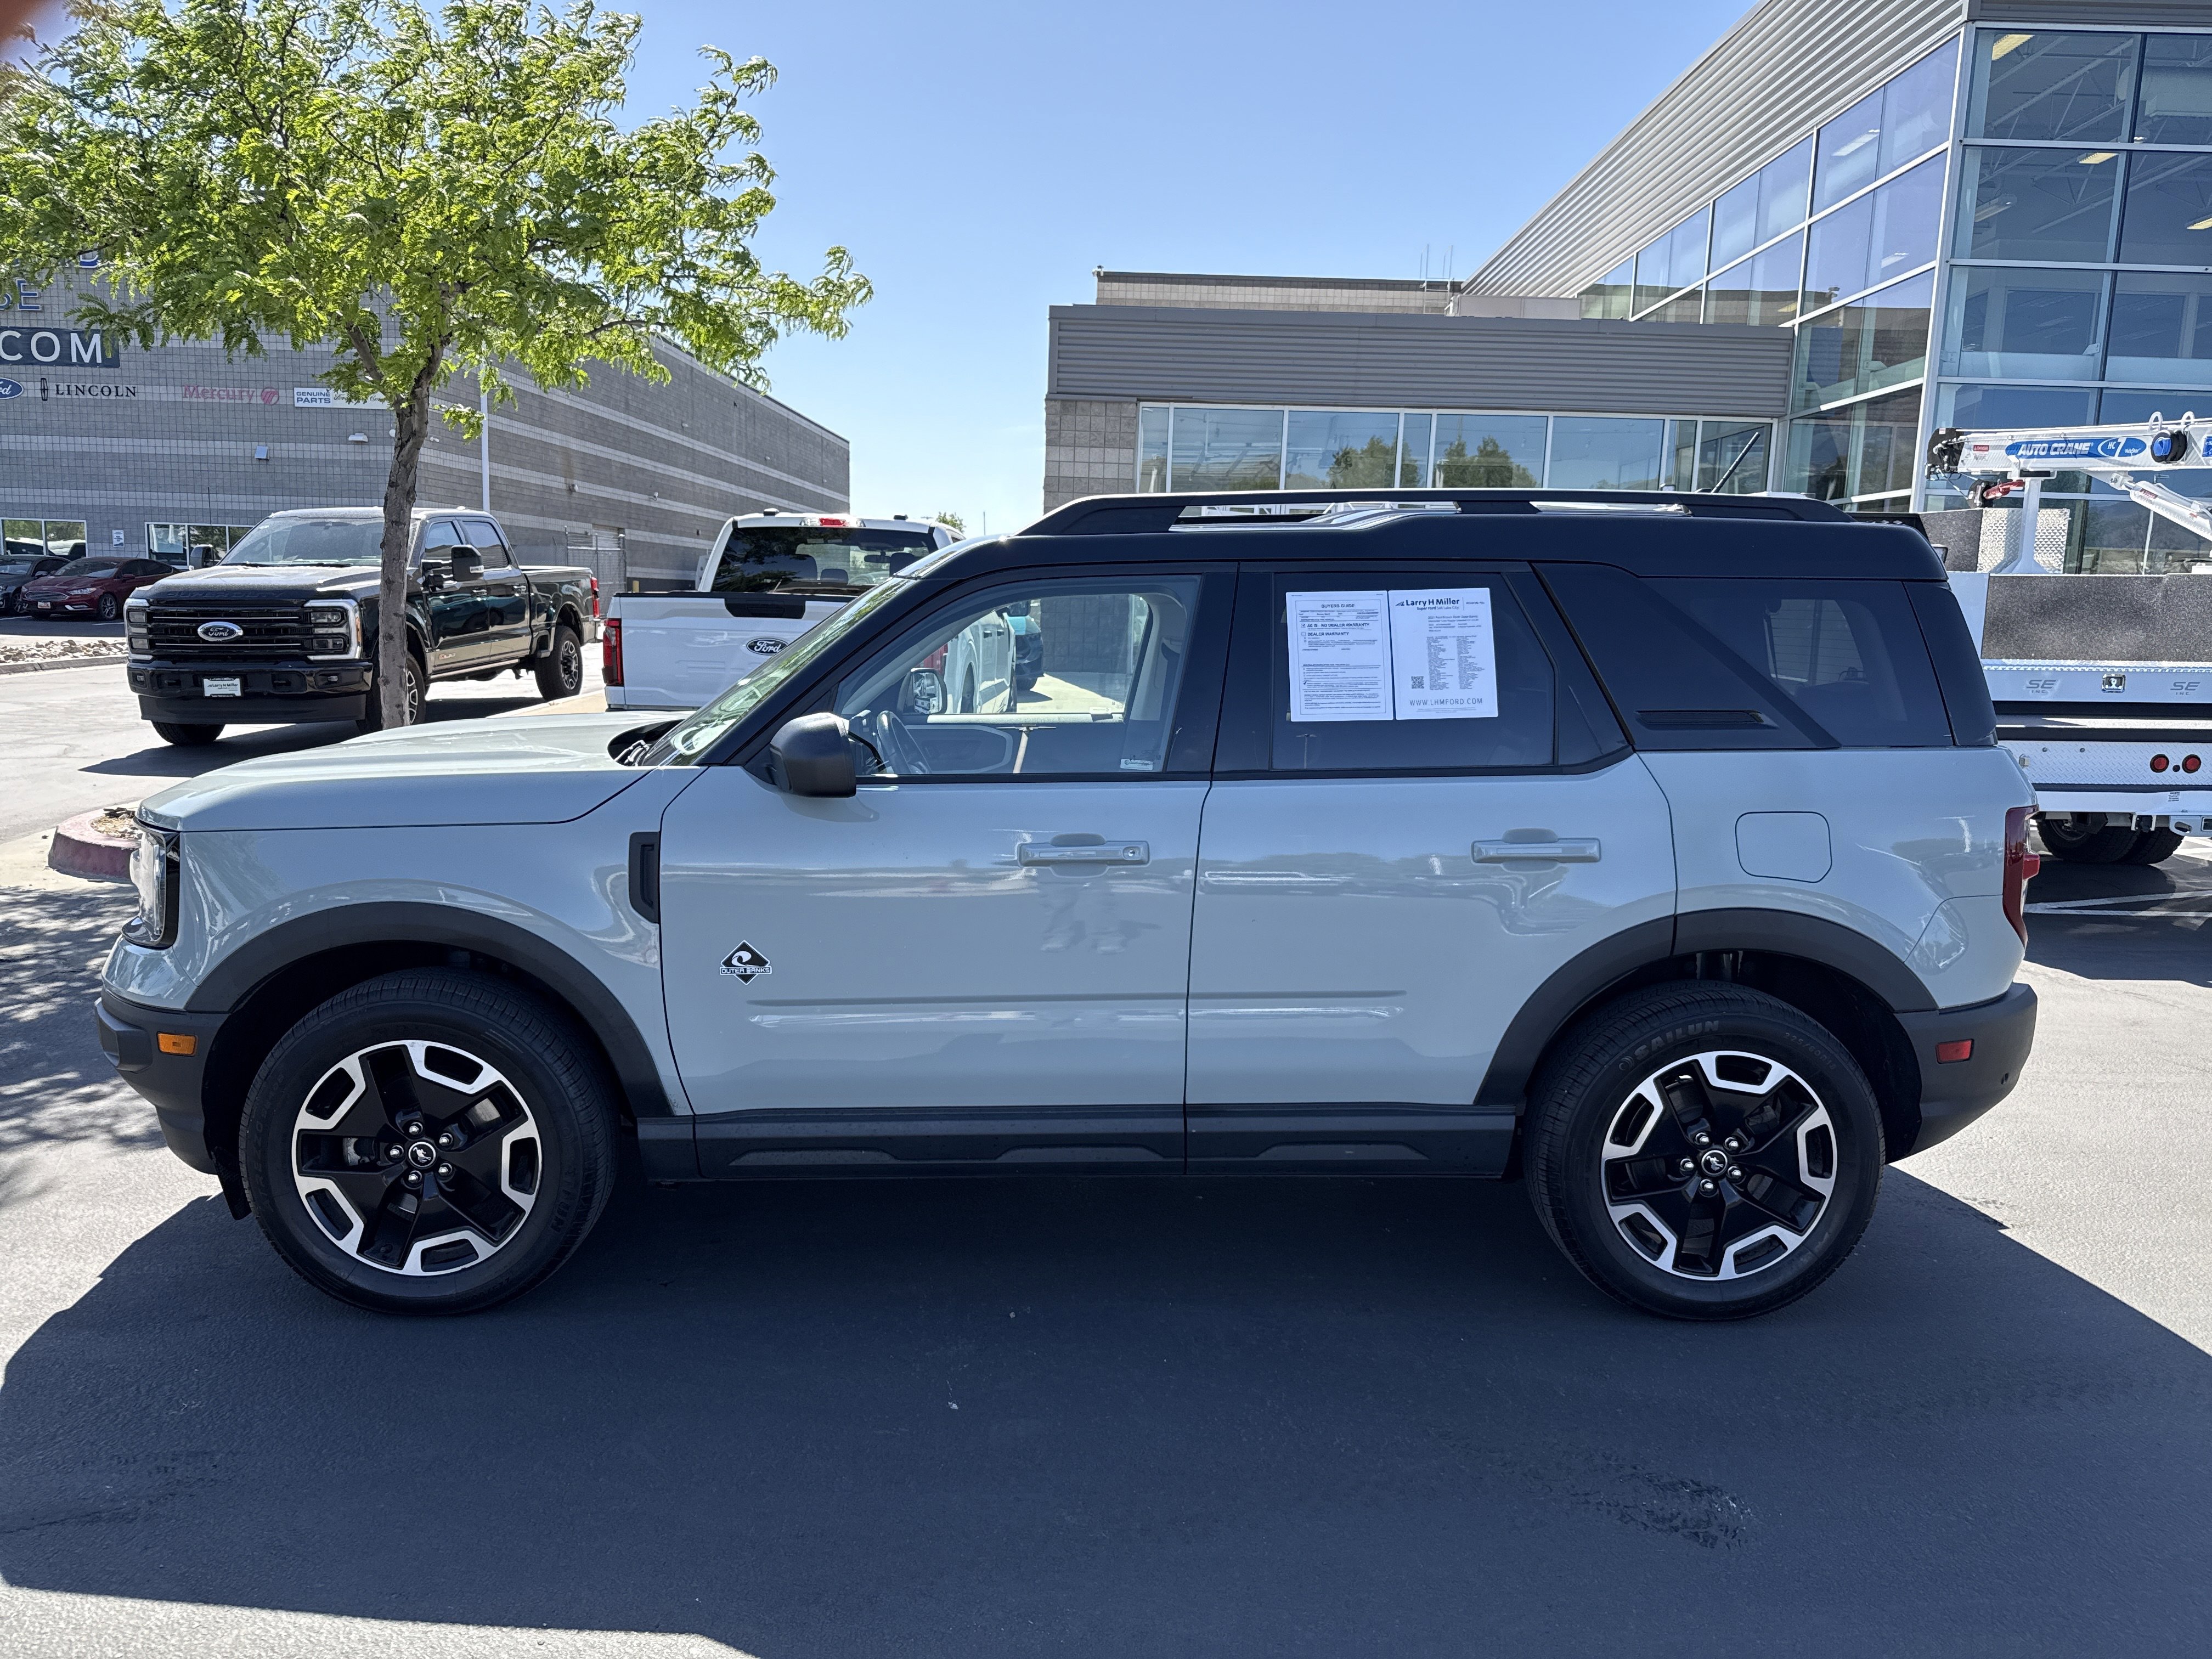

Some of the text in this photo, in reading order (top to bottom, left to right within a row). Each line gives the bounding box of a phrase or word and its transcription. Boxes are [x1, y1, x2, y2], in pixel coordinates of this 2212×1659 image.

[55, 385, 136, 397] LINCOLN
[182, 385, 255, 402] Mercury
[2017, 443, 2049, 455] AUTO
[2107, 441, 2117, 449] HC
[208, 627, 229, 636] Ford
[754, 640, 782, 652] Ford
[2026, 680, 2057, 689] SE
[2170, 681, 2201, 691] SE
[1634, 1020, 1720, 1060] SAILUN
